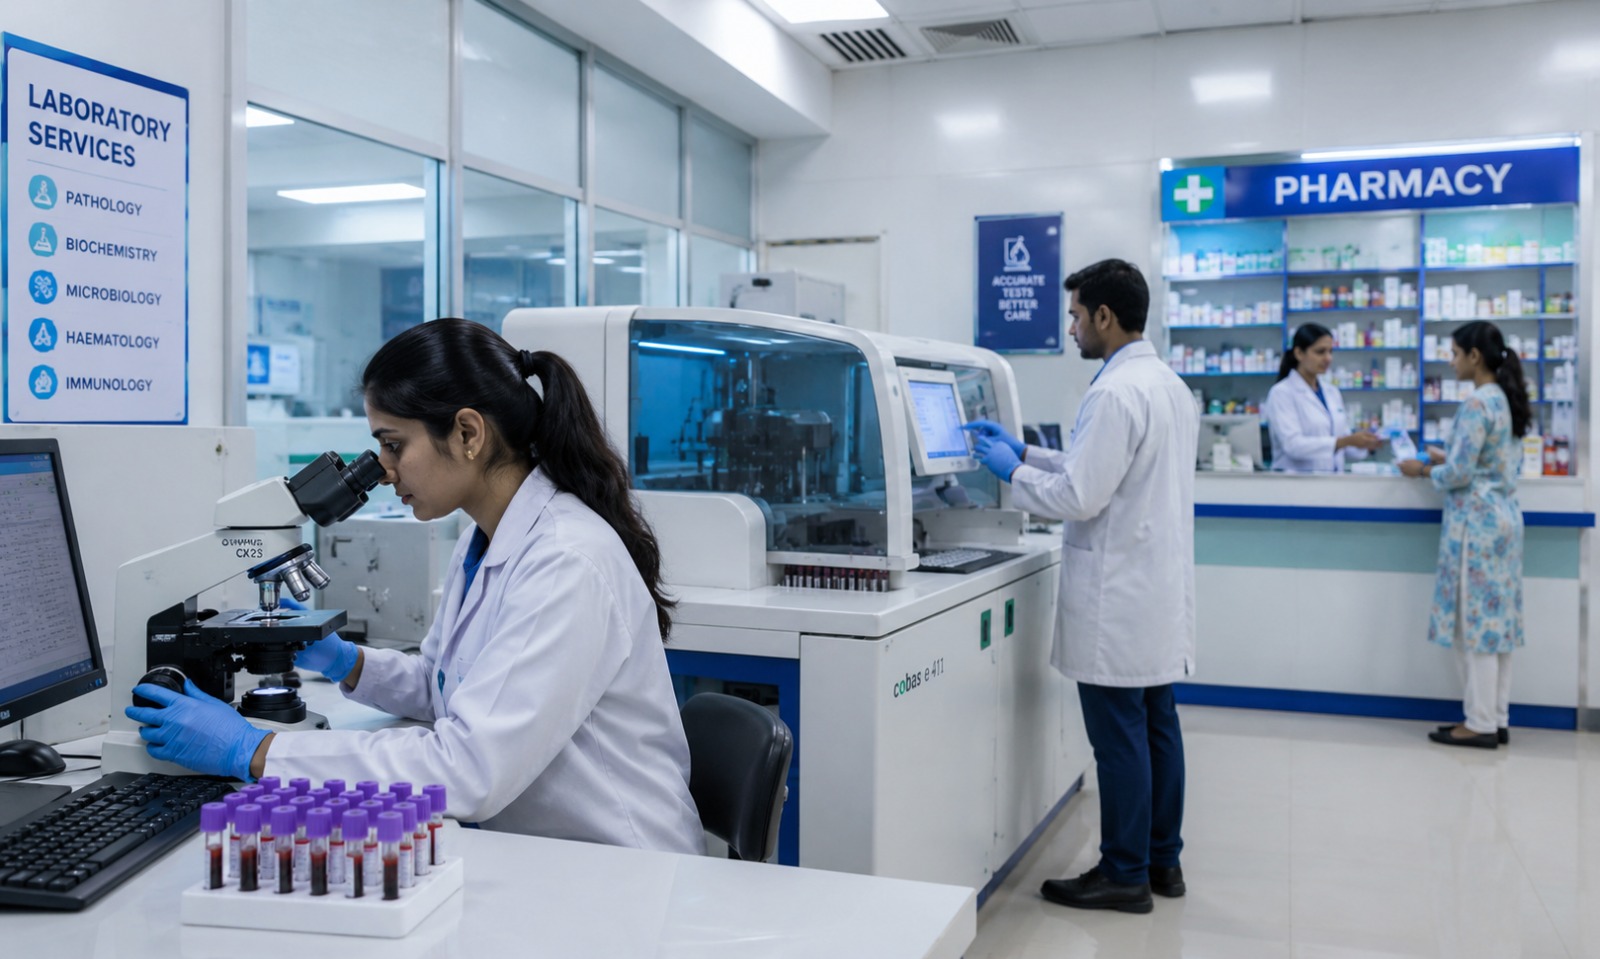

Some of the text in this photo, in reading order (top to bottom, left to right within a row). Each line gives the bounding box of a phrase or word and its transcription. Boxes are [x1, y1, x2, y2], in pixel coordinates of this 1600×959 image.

[29, 83, 171, 142] LABORATORY
[28, 121, 136, 167] SERVICES
[1275, 163, 1513, 205] PHARMACY
[66, 190, 142, 216] PATHOLOGY
[66, 237, 158, 262] BIOCHEMISTRY
[992, 274, 1046, 287] ACCURATE
[66, 284, 162, 306] MICROBIOLOGY
[1002, 287, 1034, 298] TESTS
[998, 299, 1039, 310] BETTER
[1004, 311, 1032, 321] CARE
[66, 331, 160, 350] HAEMATOLOGY
[66, 377, 153, 391] IMMUNOLOGY
[893, 657, 944, 698] cobas e 411
